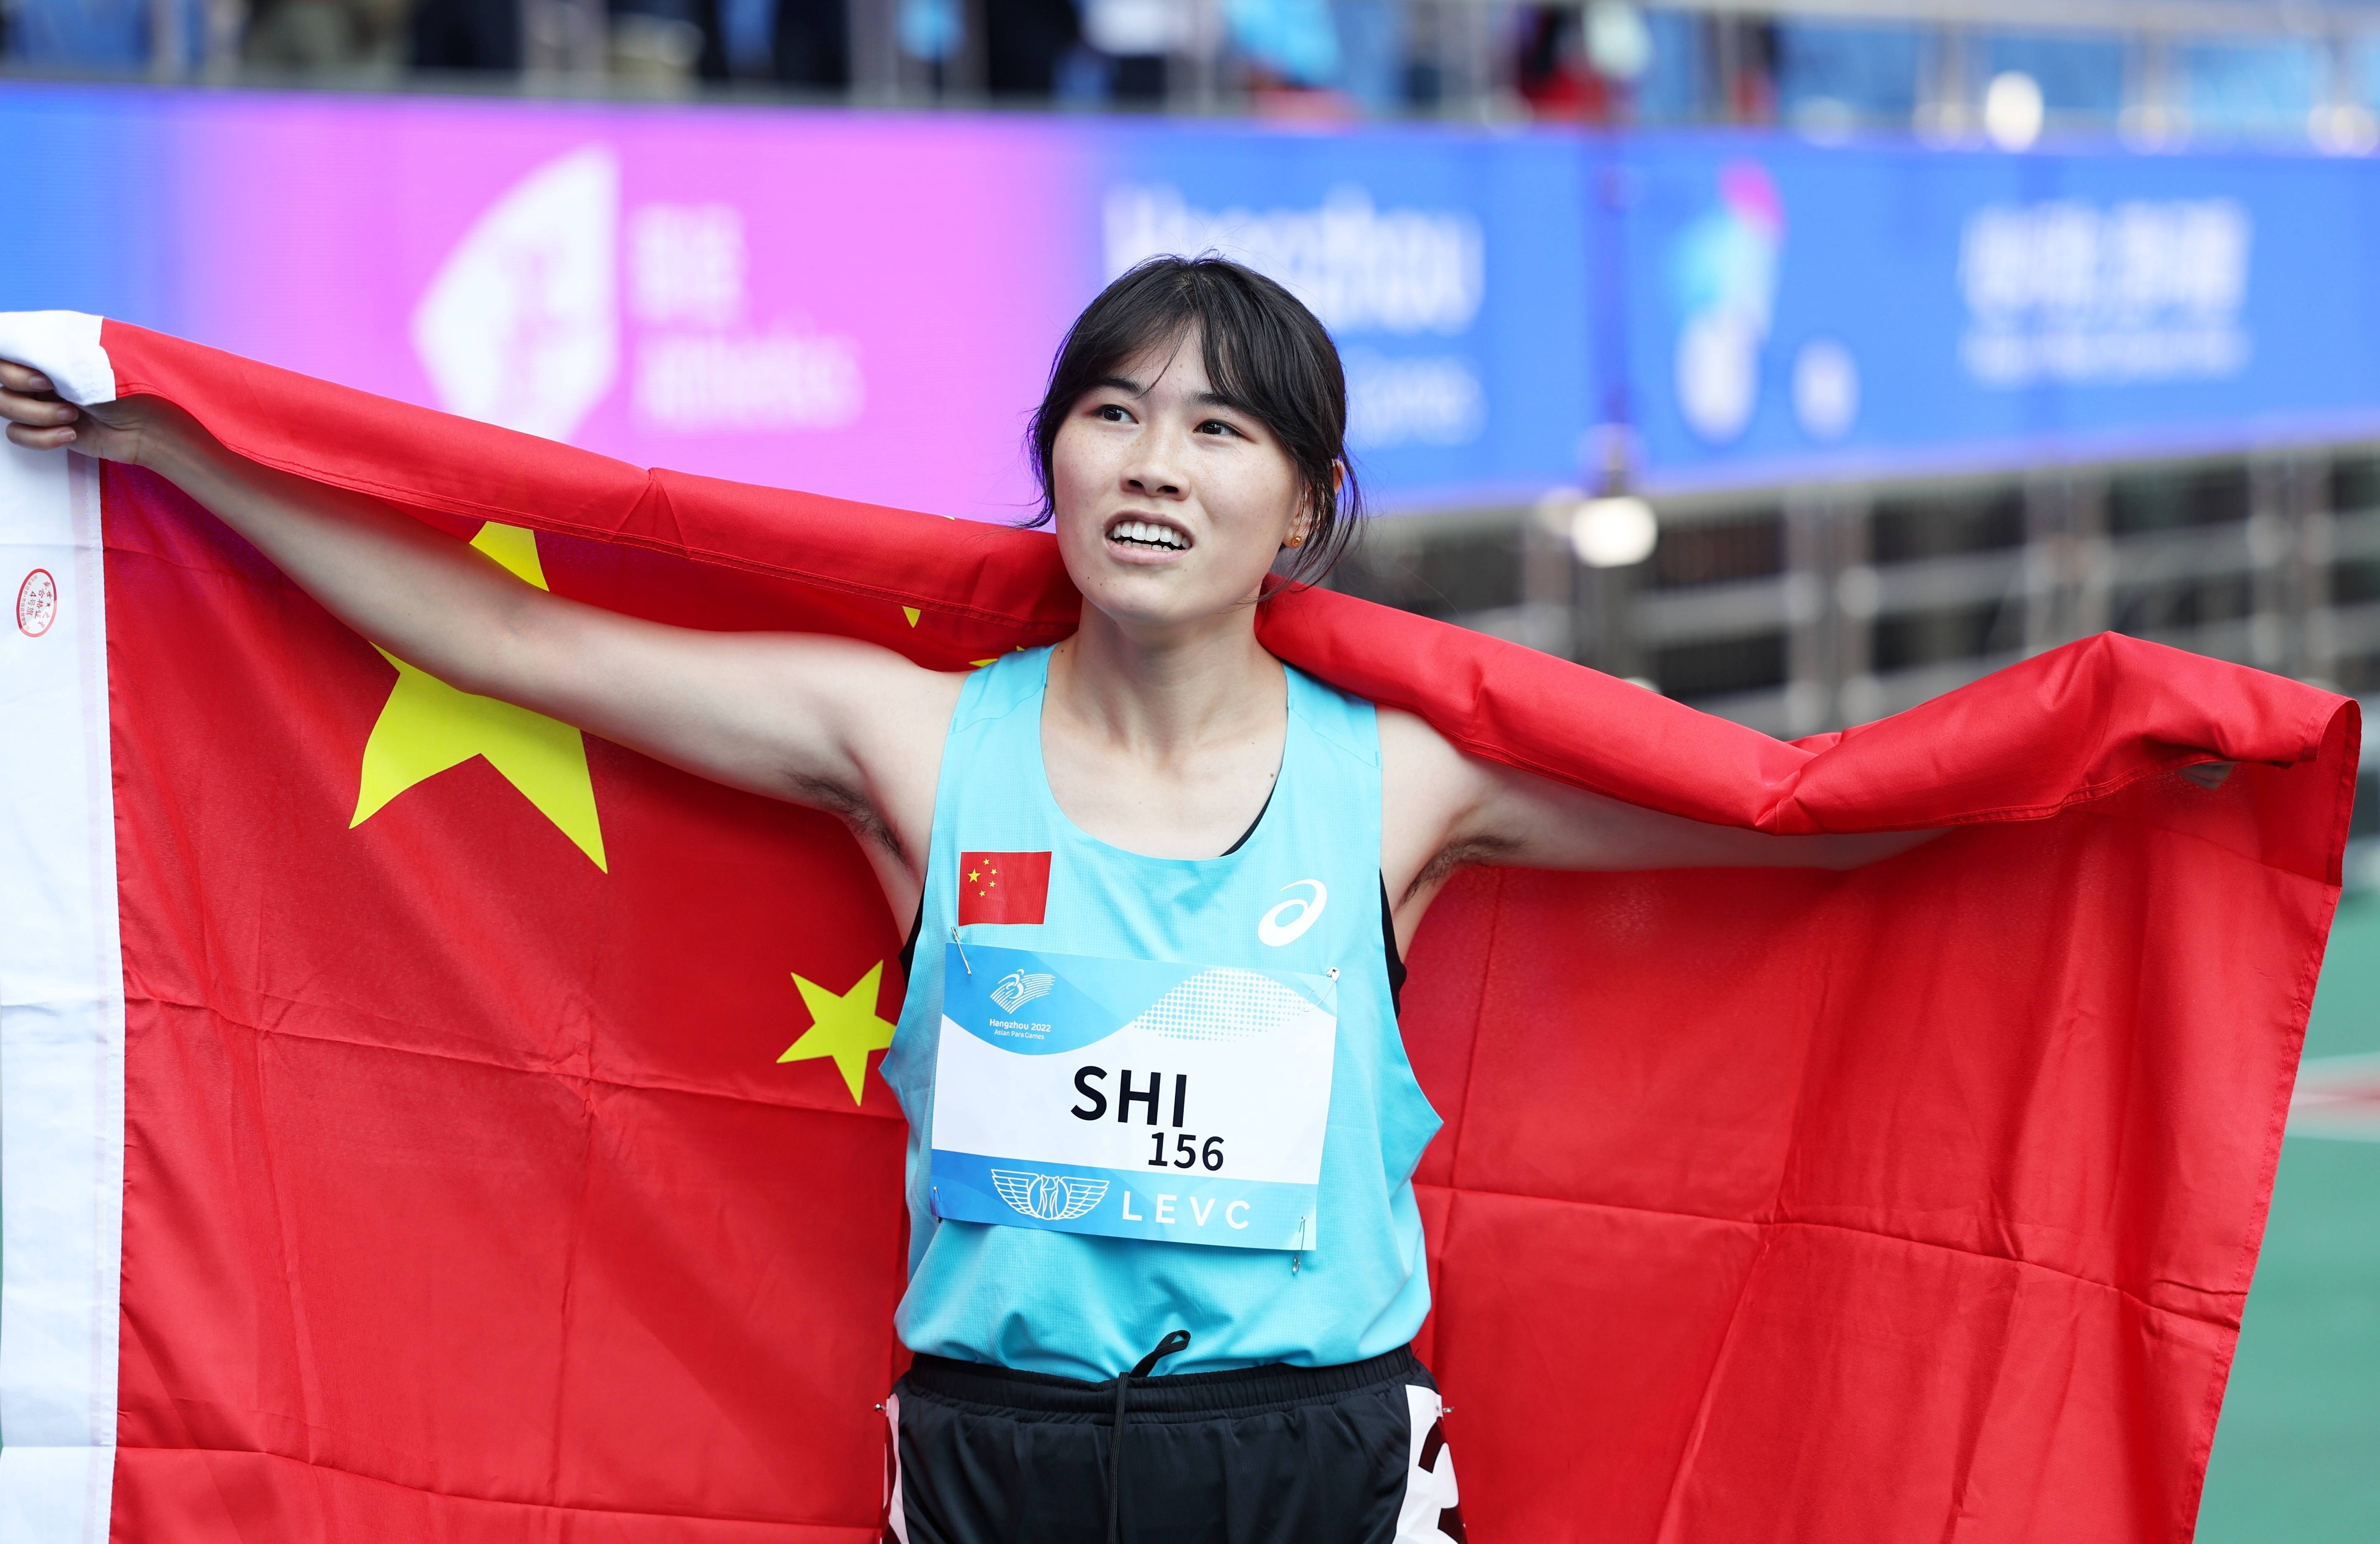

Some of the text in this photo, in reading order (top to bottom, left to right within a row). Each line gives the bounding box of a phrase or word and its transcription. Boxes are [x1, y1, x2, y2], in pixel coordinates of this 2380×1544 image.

[34, 589, 45, 619] 合格证
[989, 1019, 1051, 1032] Hangzhou 2022
[1070, 1066, 1187, 1128] SHI
[1148, 1132, 1225, 1171] 156
[1122, 1191, 1251, 1230] LEVC
